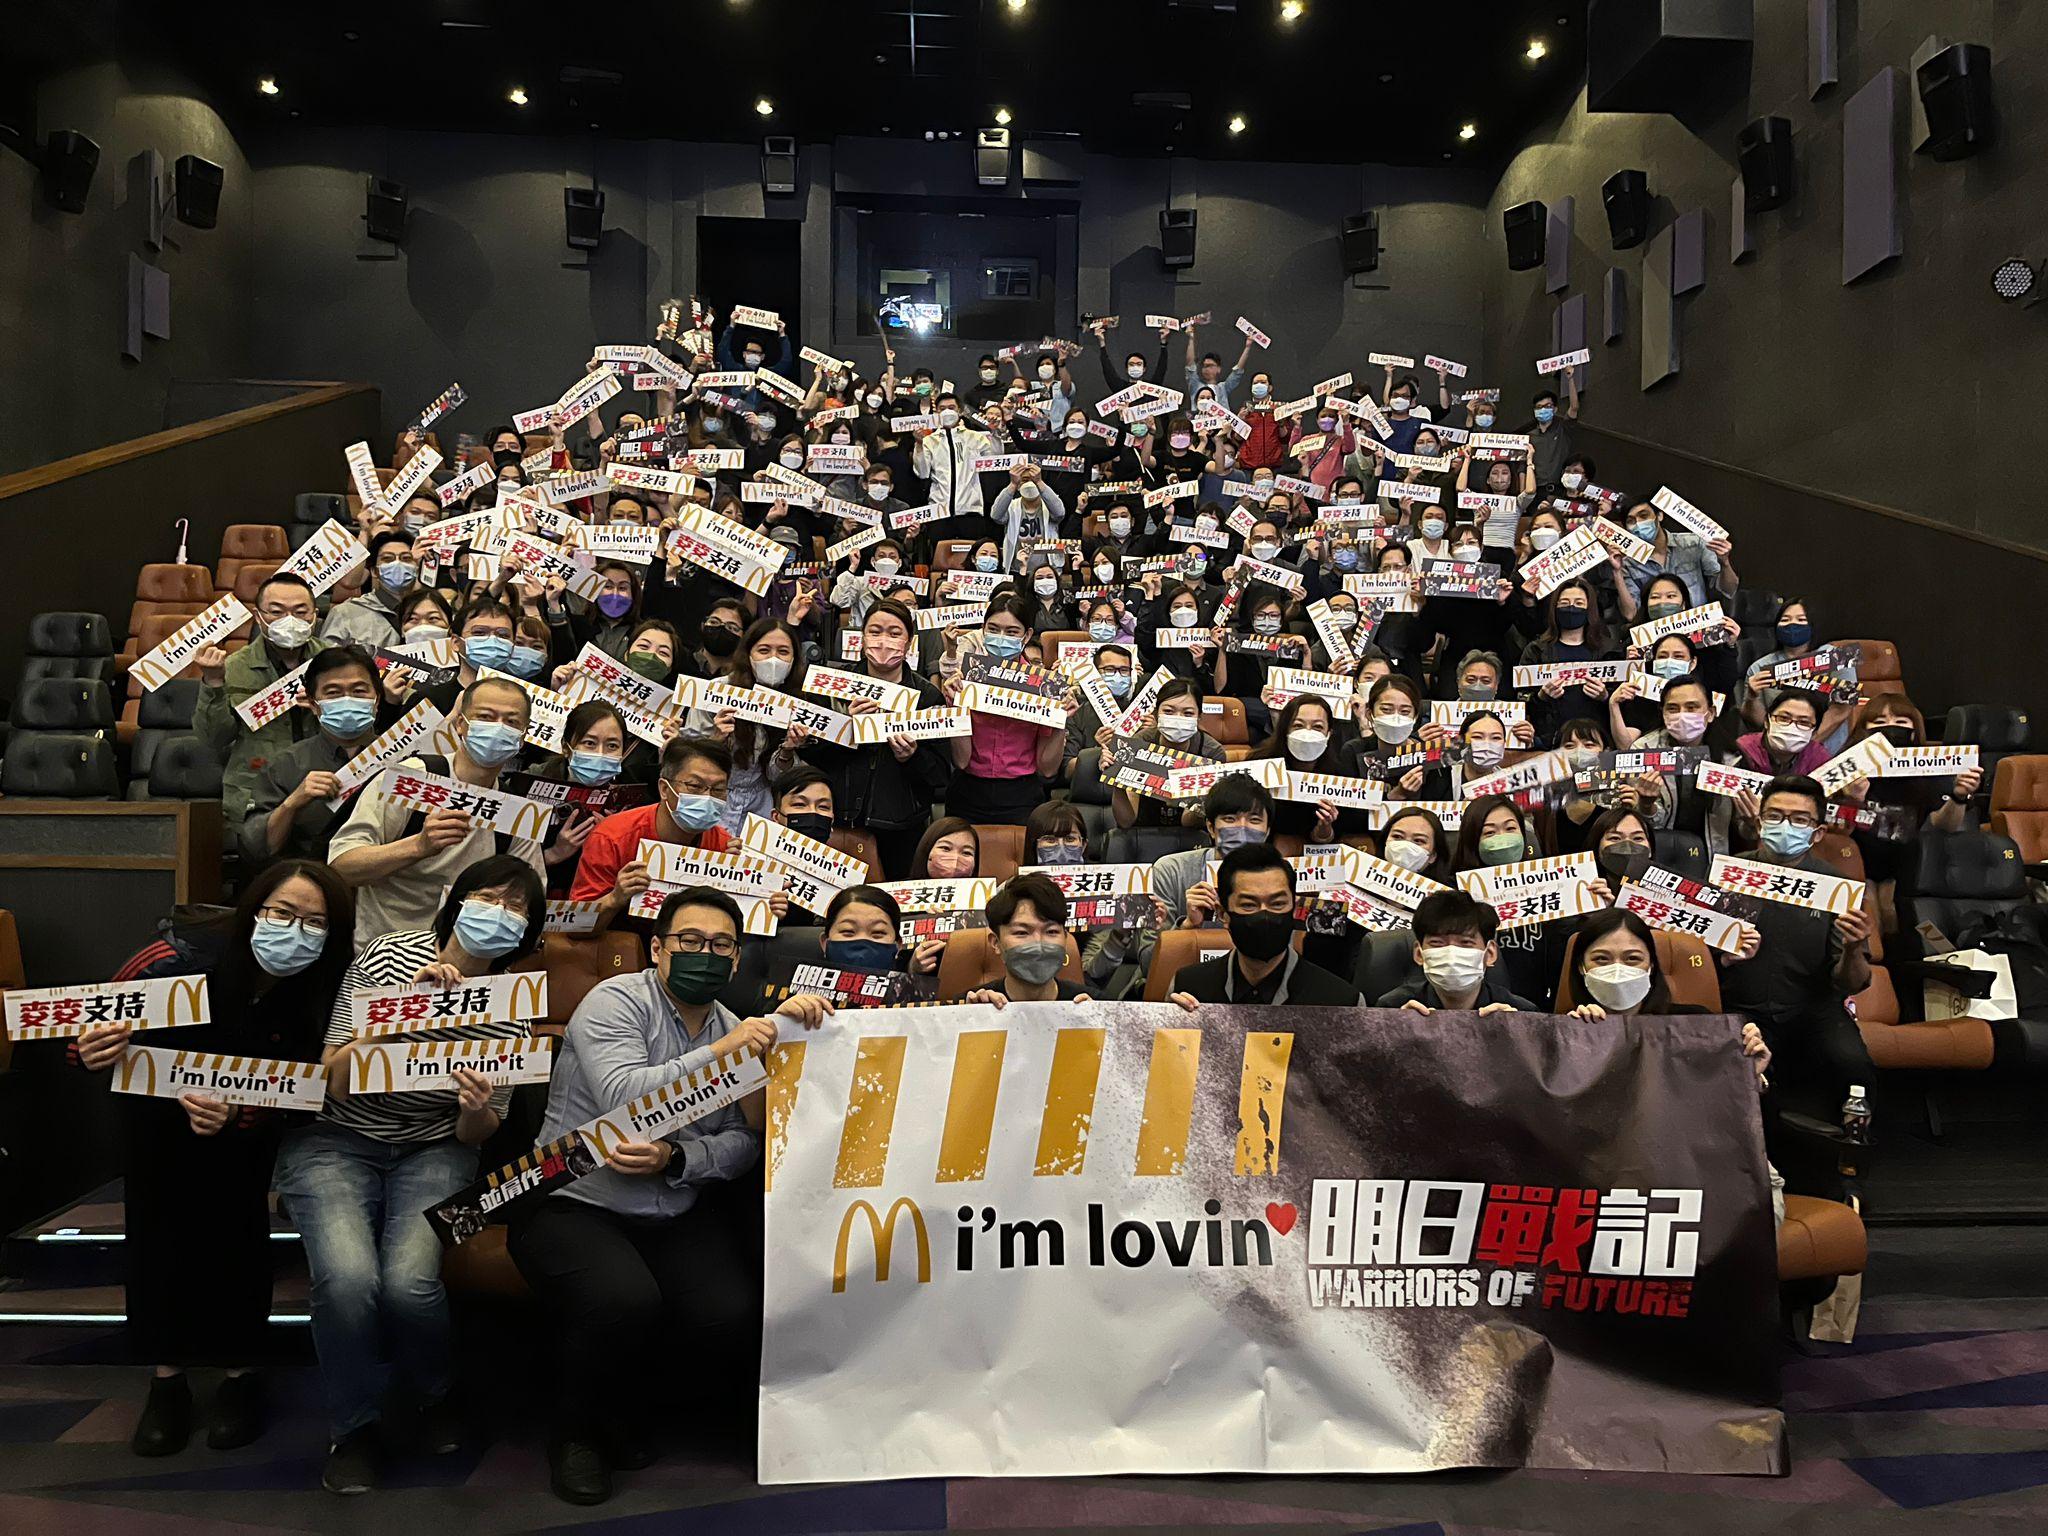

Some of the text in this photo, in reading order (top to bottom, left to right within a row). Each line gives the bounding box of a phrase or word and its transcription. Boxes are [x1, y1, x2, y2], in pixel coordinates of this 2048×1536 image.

[388, 461, 428, 507] i'm lovin it
[552, 477, 597, 497] i'm lovin it
[613, 469, 669, 487] 麥麥支持
[775, 491, 794, 499] lovin
[1394, 487, 1432, 498] i'm lovin it
[1672, 503, 1716, 537] i'm lovin it
[492, 532, 507, 547] i'm
[593, 532, 652, 544] i'm lovin it
[706, 520, 769, 558] i'm lovin it
[512, 539, 577, 581] 麥麥支持
[676, 532, 743, 575] 麥麥支持
[1527, 542, 1572, 576] 麥麥支持
[315, 551, 353, 586] lovin it
[1550, 553, 1594, 584] i'm lovin it
[952, 574, 993, 587] 麥麥支持
[1361, 579, 1407, 588] i'm lovin it
[937, 609, 984, 623] i'm lovin it
[1655, 612, 1710, 635] i'm lovin it
[164, 612, 231, 664] i'm lovin it
[1175, 633, 1189, 642] i'm
[1321, 619, 1342, 654] i'm lovin
[1537, 670, 1551, 680] i'm
[1558, 664, 1616, 681] 麥麥支持
[1774, 653, 1830, 676] 明日戰記
[584, 653, 654, 700] 麥麥支持
[811, 672, 886, 700] 麥麥支持
[987, 665, 1043, 688] 並肩作戰
[1290, 675, 1341, 691] i'm lovin it
[704, 690, 774, 716] i'm lovin it
[984, 694, 1051, 717] i'm lovin it
[1087, 680, 1113, 718] i'm lovin
[884, 717, 954, 733] i'm lovin it
[1505, 709, 1512, 718] it
[1135, 748, 1190, 768] 並肩作戰
[1615, 752, 1677, 768] 明日戰記
[1889, 756, 1962, 768] i'm lovin it
[394, 775, 502, 820] 麥麥支持
[529, 780, 611, 804] 明日戰記
[1300, 782, 1367, 799] i'm lovin it
[776, 836, 848, 878] i'm lovin it
[857, 843, 863, 853] 9
[1688, 847, 1699, 857] 14
[2003, 849, 2014, 859] 16
[675, 857, 763, 885] i'm lovin it
[1315, 867, 1326, 880] it
[1494, 865, 1578, 889] i'm lovin it
[1721, 865, 1818, 899] 麥麥支持
[1366, 867, 1427, 900] i'm lovin
[1640, 866, 1721, 906] 明日戰記
[563, 911, 575, 923] it
[1626, 894, 1713, 934] 麥麥支持
[614, 955, 621, 967] 8
[1689, 955, 1702, 967] 13
[791, 963, 890, 998] 明日戰記
[367, 987, 491, 1025] 麥麥支持
[836, 991, 848, 1001] OF
[20, 992, 146, 1028] 麥麥支持
[406, 1058, 439, 1076] i'm
[509, 1053, 524, 1071] it
[170, 1065, 296, 1094] i'm lovin it
[631, 1071, 740, 1133] i'm lovin it
[480, 1153, 566, 1214] 並肩作戰
[957, 1200, 1273, 1271] i'm lovin
[1308, 1179, 1703, 1277] 明日戰記
[1308, 1268, 1693, 1318] WARRIORS OF FUTURE
